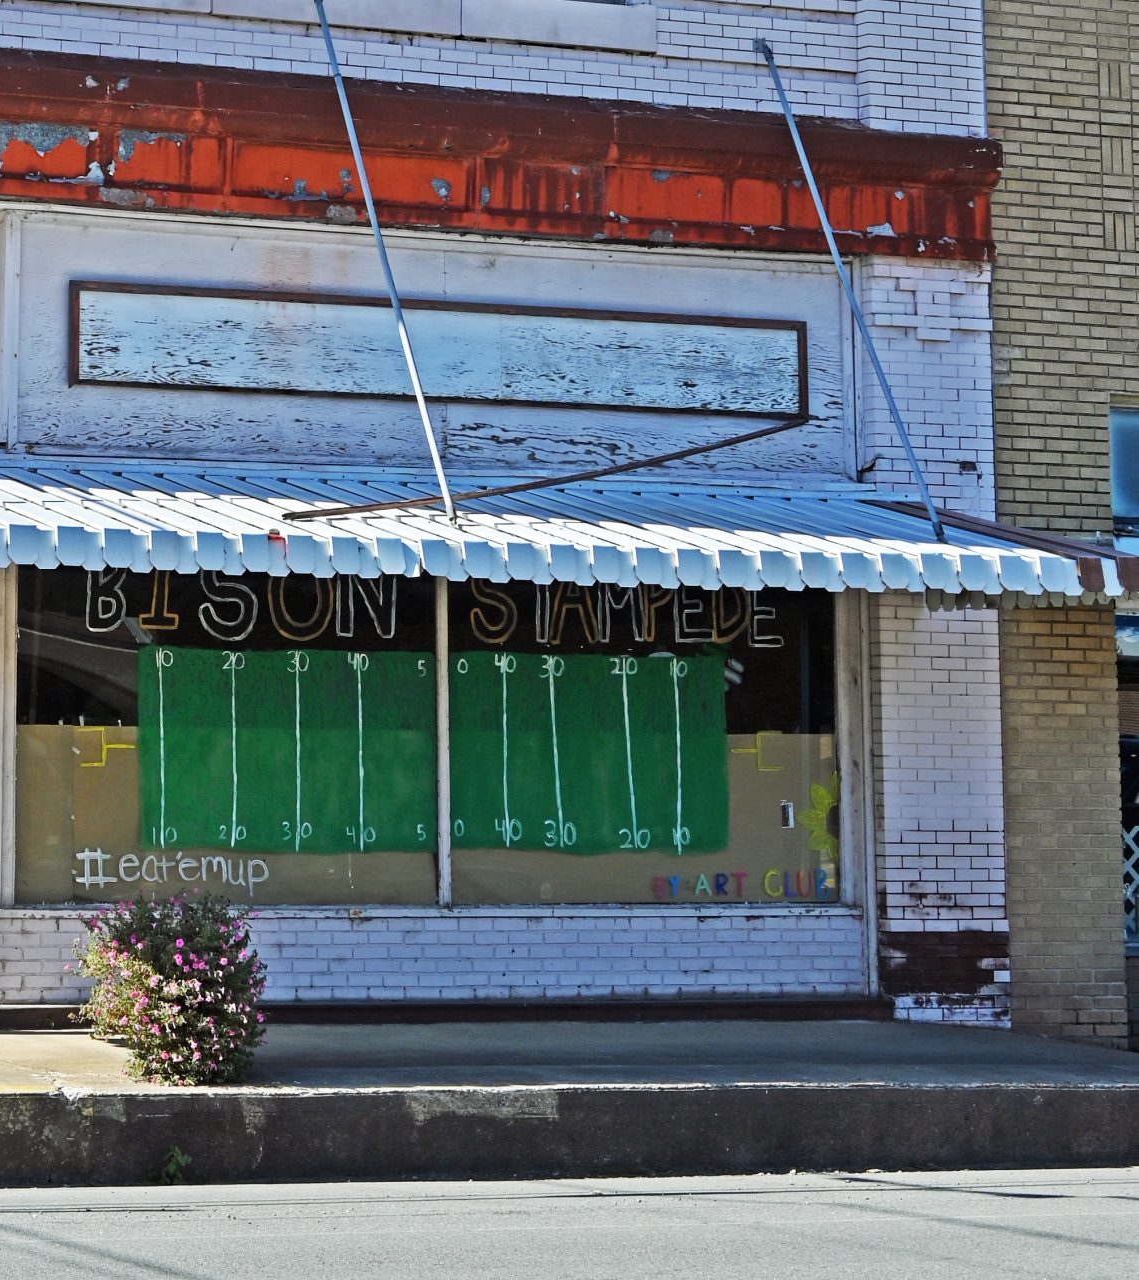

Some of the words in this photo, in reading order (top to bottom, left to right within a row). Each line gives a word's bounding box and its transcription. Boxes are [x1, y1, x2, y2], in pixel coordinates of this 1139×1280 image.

[85, 568, 397, 641] BISON
[222, 650, 245, 671] 20
[286, 650, 309, 672] 30
[610, 656, 639, 675] 20
[219, 824, 247, 841] 20
[282, 821, 313, 841] 30
[346, 826, 377, 844] 40
[544, 820, 577, 848] 30
[619, 828, 651, 849] 20
[694, 872, 749, 898] ART
[764, 869, 831, 900] CLUB
